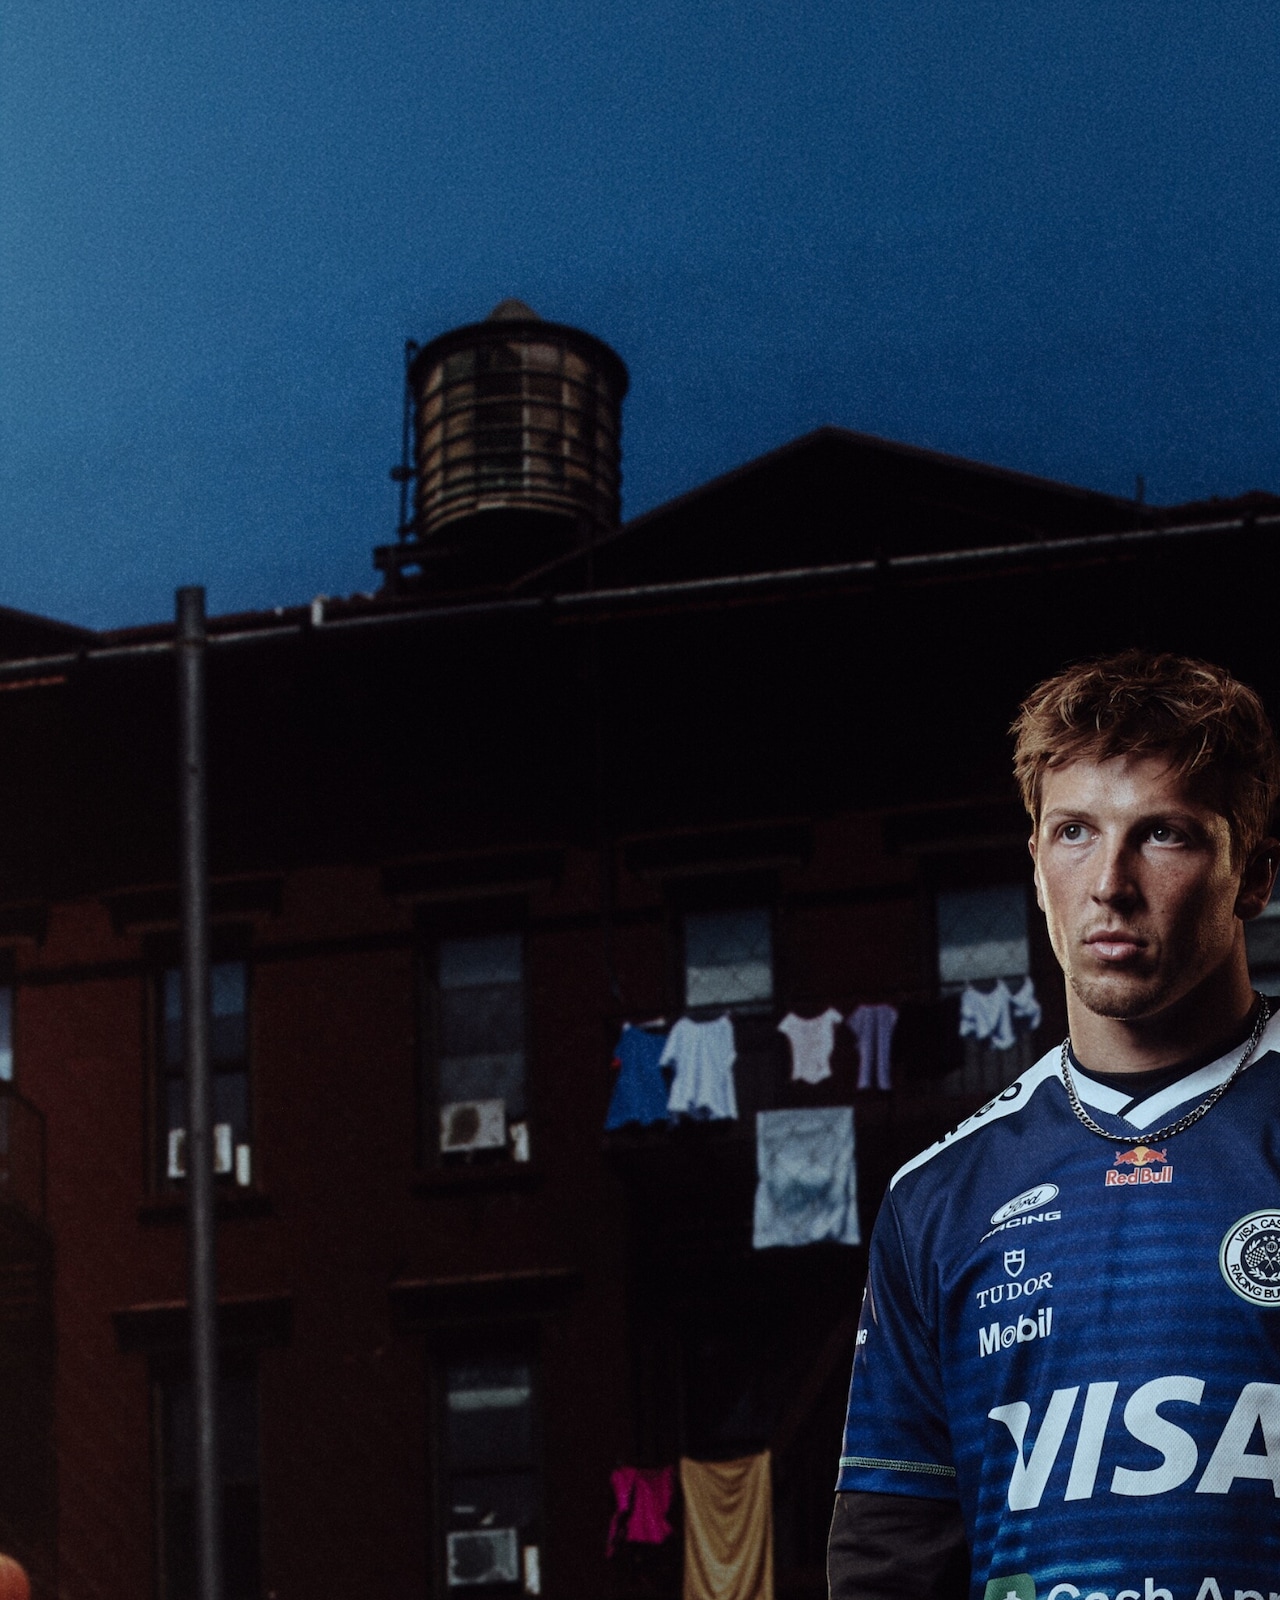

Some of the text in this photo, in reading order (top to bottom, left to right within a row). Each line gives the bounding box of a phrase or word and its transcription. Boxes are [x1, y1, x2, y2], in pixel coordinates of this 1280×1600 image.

[1105, 1166, 1174, 1187] Red Bull
[1002, 1190, 1043, 1219] Ford
[1235, 1223, 1260, 1243] VISA
[976, 1271, 1054, 1309] TUDOR
[1230, 1263, 1263, 1296] RACING
[979, 1306, 1053, 1358] Mobil
